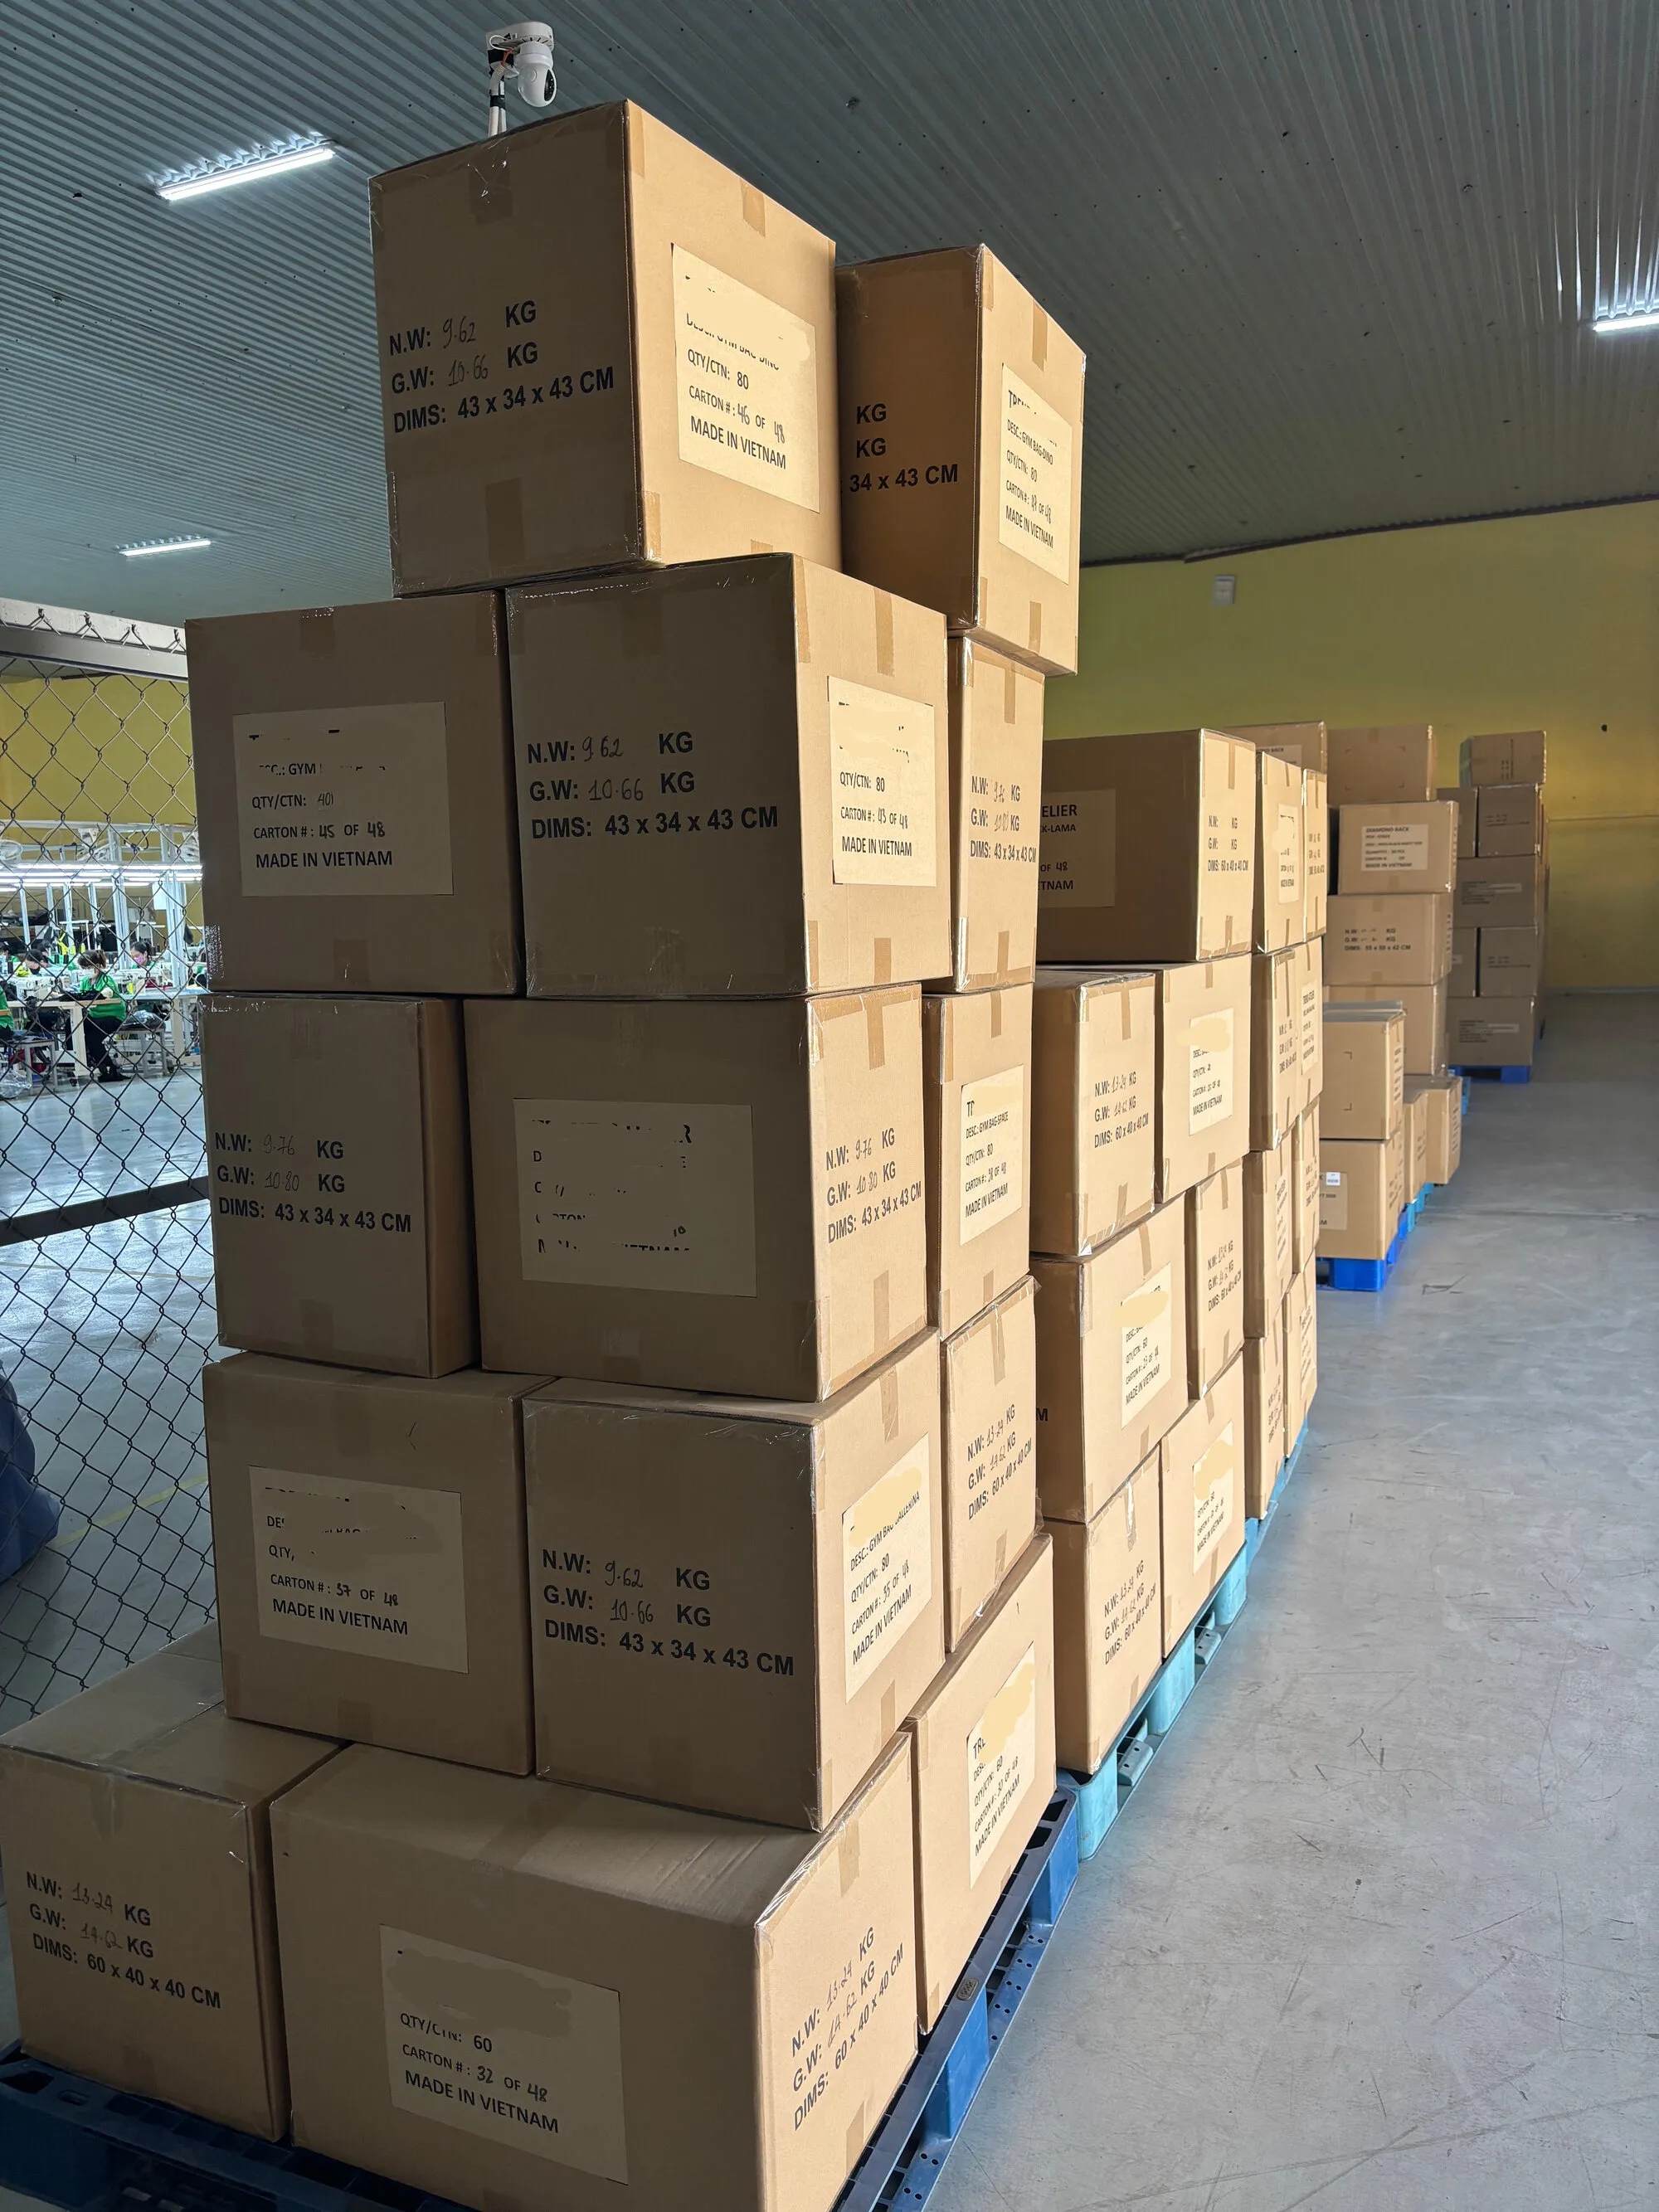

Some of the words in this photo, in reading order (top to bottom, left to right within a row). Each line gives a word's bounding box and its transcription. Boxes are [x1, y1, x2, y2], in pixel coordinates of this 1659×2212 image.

[390, 328, 431, 355] N.W:
[506, 300, 536, 328] KG
[392, 367, 434, 394] G.W:
[508, 342, 538, 368] KG
[688, 348, 730, 381] QTY/CTN:
[737, 371, 749, 390] 80
[394, 405, 445, 433] DIMS:
[458, 396, 479, 418] 43
[504, 386, 526, 410] 34
[550, 376, 572, 399] 43
[580, 367, 613, 393] CM
[688, 385, 724, 412] CARTON
[737, 403, 750, 425] 46
[756, 415, 766, 429] OF
[774, 421, 786, 444] 48
[857, 403, 887, 425] KG
[691, 416, 724, 444] MADE
[727, 430, 738, 450] IN
[741, 435, 786, 469] VIETNAM
[856, 437, 886, 458] KG
[849, 474, 872, 493] 34
[895, 468, 918, 488] 43
[925, 464, 958, 485] CM
[1006, 450, 1029, 475] QTY/CTN:
[1030, 466, 1037, 483] 80
[1005, 505, 1023, 529] MADE
[1023, 516, 1030, 532] IN
[1030, 520, 1053, 549] VIETNAM
[527, 741, 575, 764] N.W:
[659, 731, 693, 755] KG
[288, 763, 316, 775] GYM
[529, 779, 579, 802] G.W:
[588, 777, 644, 801] 10.66
[660, 771, 695, 794] KG
[839, 771, 872, 789] QTY/CTN:
[876, 776, 885, 793] 80
[251, 795, 307, 810] QTY/CTN:
[971, 775, 989, 795] N.W:
[1011, 784, 1020, 802] KG
[253, 826, 298, 839] CARTON
[319, 824, 335, 839] 45
[343, 824, 359, 836] OF
[367, 821, 386, 838] 48
[532, 816, 591, 839] DIMS:
[605, 814, 630, 836] 43
[655, 811, 681, 834] 34
[707, 809, 733, 830] 43
[741, 805, 778, 829] CM
[840, 806, 867, 822] CARTON
[889, 812, 898, 825] OF
[899, 814, 908, 829] 48
[971, 808, 989, 827] G.W:
[1010, 814, 1019, 832] KG
[255, 853, 299, 868] MADE
[303, 852, 318, 867] IN
[322, 850, 392, 867] VIETNAM
[842, 835, 866, 853] MADE
[868, 839, 877, 854] IN
[878, 839, 912, 857] VIETNAM
[970, 839, 991, 858] DIMS:
[1056, 861, 1068, 871] 48
[1095, 1081, 1110, 1096] N.W:
[215, 1132, 252, 1152] N.W:
[317, 1140, 343, 1159] KG
[826, 1145, 849, 1170] N.W:
[882, 1127, 894, 1149] KG
[1095, 1130, 1112, 1148] DIMS:
[217, 1164, 254, 1185] G.W:
[319, 1174, 345, 1193] KG
[827, 1181, 850, 1206] G.W:
[883, 1160, 895, 1182] KG
[219, 1197, 264, 1218] DIMS:
[275, 1203, 294, 1222] 43
[314, 1207, 333, 1225] 34
[355, 1211, 375, 1229] 43
[382, 1213, 411, 1232] CM
[966, 1198, 980, 1218] MADE
[981, 1195, 987, 1208] IN
[987, 1183, 1008, 1205] VIETNAM
[829, 1214, 856, 1243] DIMS:
[967, 1434, 985, 1462] N.W:
[1005, 1403, 1015, 1425] KG
[968, 1463, 985, 1490] G.W:
[1007, 1431, 1016, 1453] KG
[969, 1490, 990, 1520] DIMS:
[542, 1549, 591, 1574] N.W:
[675, 1568, 710, 1591] KG
[851, 1568, 878, 1603] QTY/CTN:
[882, 1553, 889, 1572] 80
[270, 1573, 314, 1592] CARTON
[360, 1588, 375, 1601] OF
[383, 1592, 399, 1607] 48
[543, 1584, 593, 1610] G.W:
[610, 1598, 654, 1624] 10.66
[677, 1604, 711, 1627] KG
[273, 1598, 315, 1619] MADE
[319, 1607, 335, 1622] IN
[338, 1609, 408, 1636] VIETNAM
[852, 1603, 873, 1635] CARTON
[854, 1628, 873, 1665] MADE
[875, 1618, 882, 1639] IN
[883, 1584, 912, 1628] VIETNAM
[545, 1619, 606, 1647] DIMS:
[757, 1652, 794, 1676] CM
[975, 1822, 990, 1856] MADE
[992, 1811, 997, 1826] IN
[998, 1773, 1019, 1816] VIETNAM
[27, 1871, 62, 1899] N.W:
[124, 1903, 151, 1926] KG
[30, 1903, 66, 1930] G.W:
[127, 1936, 153, 1958] KG
[33, 1932, 78, 1964] DIMS:
[87, 1953, 105, 1973] 60
[125, 1967, 144, 1986] 40
[165, 1979, 185, 1999] 40
[192, 1986, 221, 2009] CM
[792, 2007, 820, 2057] N.W:
[859, 1927, 873, 1962] KG
[793, 2043, 821, 2092] G.W:
[860, 1960, 875, 1996] KG
[474, 2035, 492, 2053] 60
[402, 2044, 452, 2070] CARTON
[477, 2065, 494, 2083] 32
[504, 2076, 521, 2091] OF
[528, 2083, 548, 2102] 48
[406, 2069, 454, 2098] MADE
[459, 2087, 474, 2106] IN
[479, 2094, 558, 2133] VIETNAM
[795, 2071, 829, 2131] DIMS:
